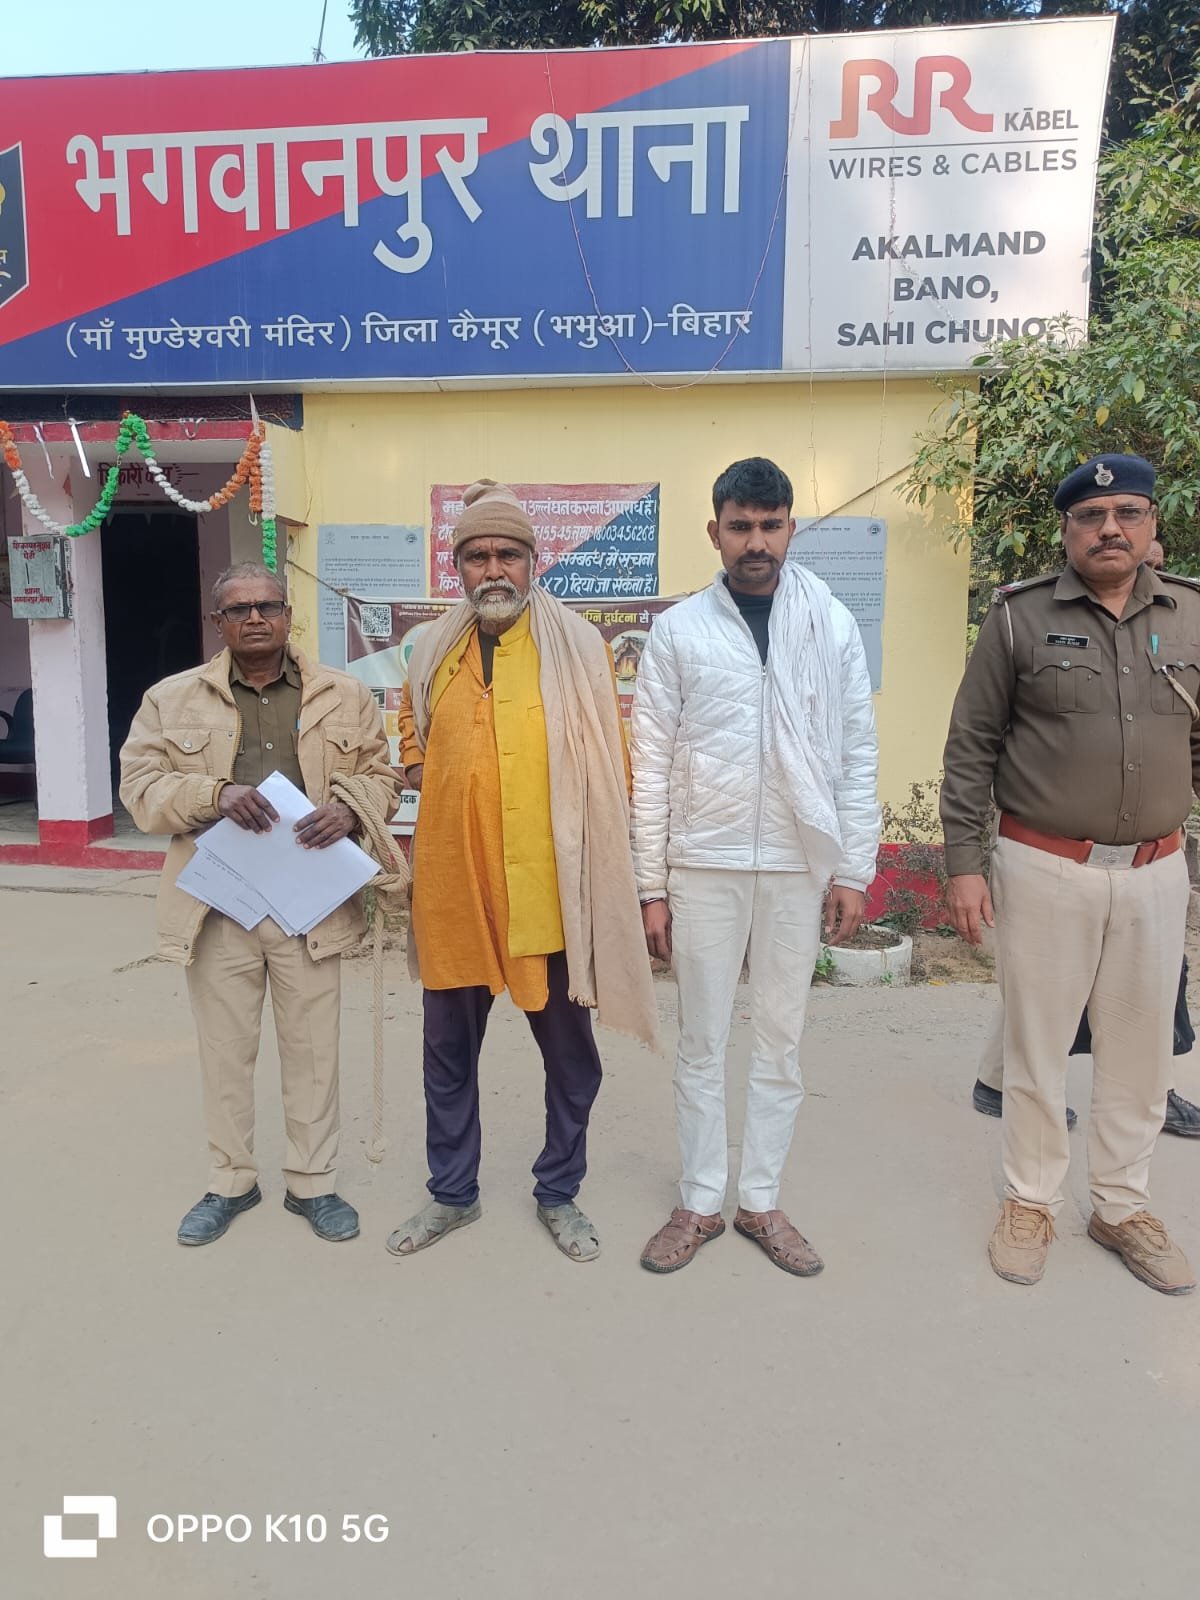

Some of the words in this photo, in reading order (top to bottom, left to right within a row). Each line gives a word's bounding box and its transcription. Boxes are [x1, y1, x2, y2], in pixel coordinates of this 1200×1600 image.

[829, 55, 994, 139] RR
[1004, 107, 1079, 133] KĀBEL
[828, 156, 922, 180] WIRES
[932, 154, 950, 176] &
[961, 148, 1077, 175] CABLES
[66, 117, 488, 274] भगवानपुर
[528, 105, 750, 218] थाना
[851, 231, 1047, 261] AKALMAND
[893, 274, 999, 303] BANO,
[66, 318, 115, 358] (माँ
[121, 315, 252, 360] मुण्डेश्वरी
[261, 314, 352, 352] मंदिर)
[361, 312, 438, 344] जिला
[448, 309, 522, 350] कैमूर
[837, 321, 914, 347] SAHI
